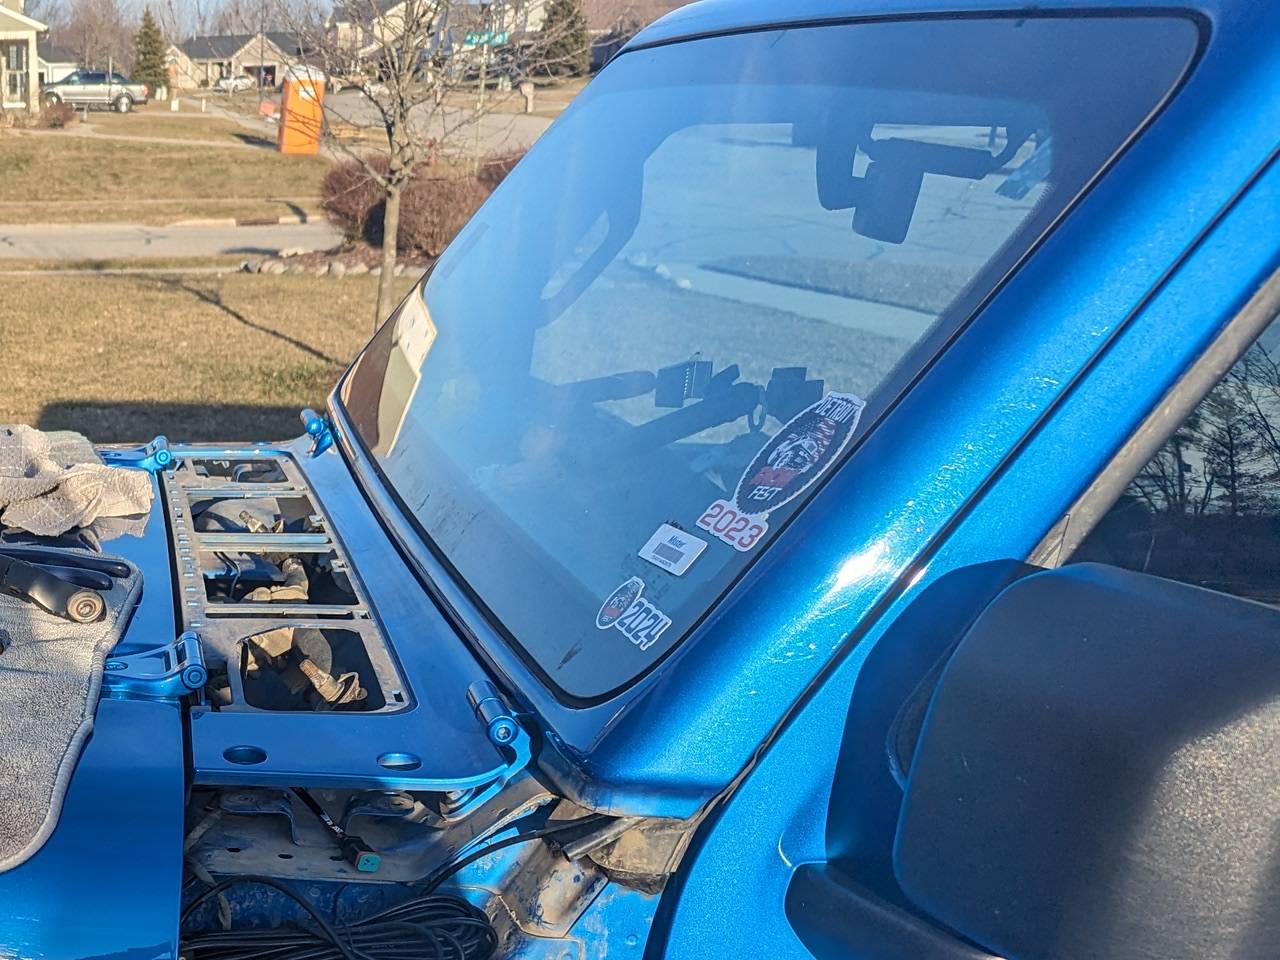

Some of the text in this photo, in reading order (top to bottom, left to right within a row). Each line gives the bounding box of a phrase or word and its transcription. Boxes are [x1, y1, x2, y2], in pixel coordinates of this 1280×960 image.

[815, 397, 858, 423] DETROIT
[747, 486, 782, 500] FEST
[698, 503, 763, 548] 2023
[617, 600, 669, 646] 2024
